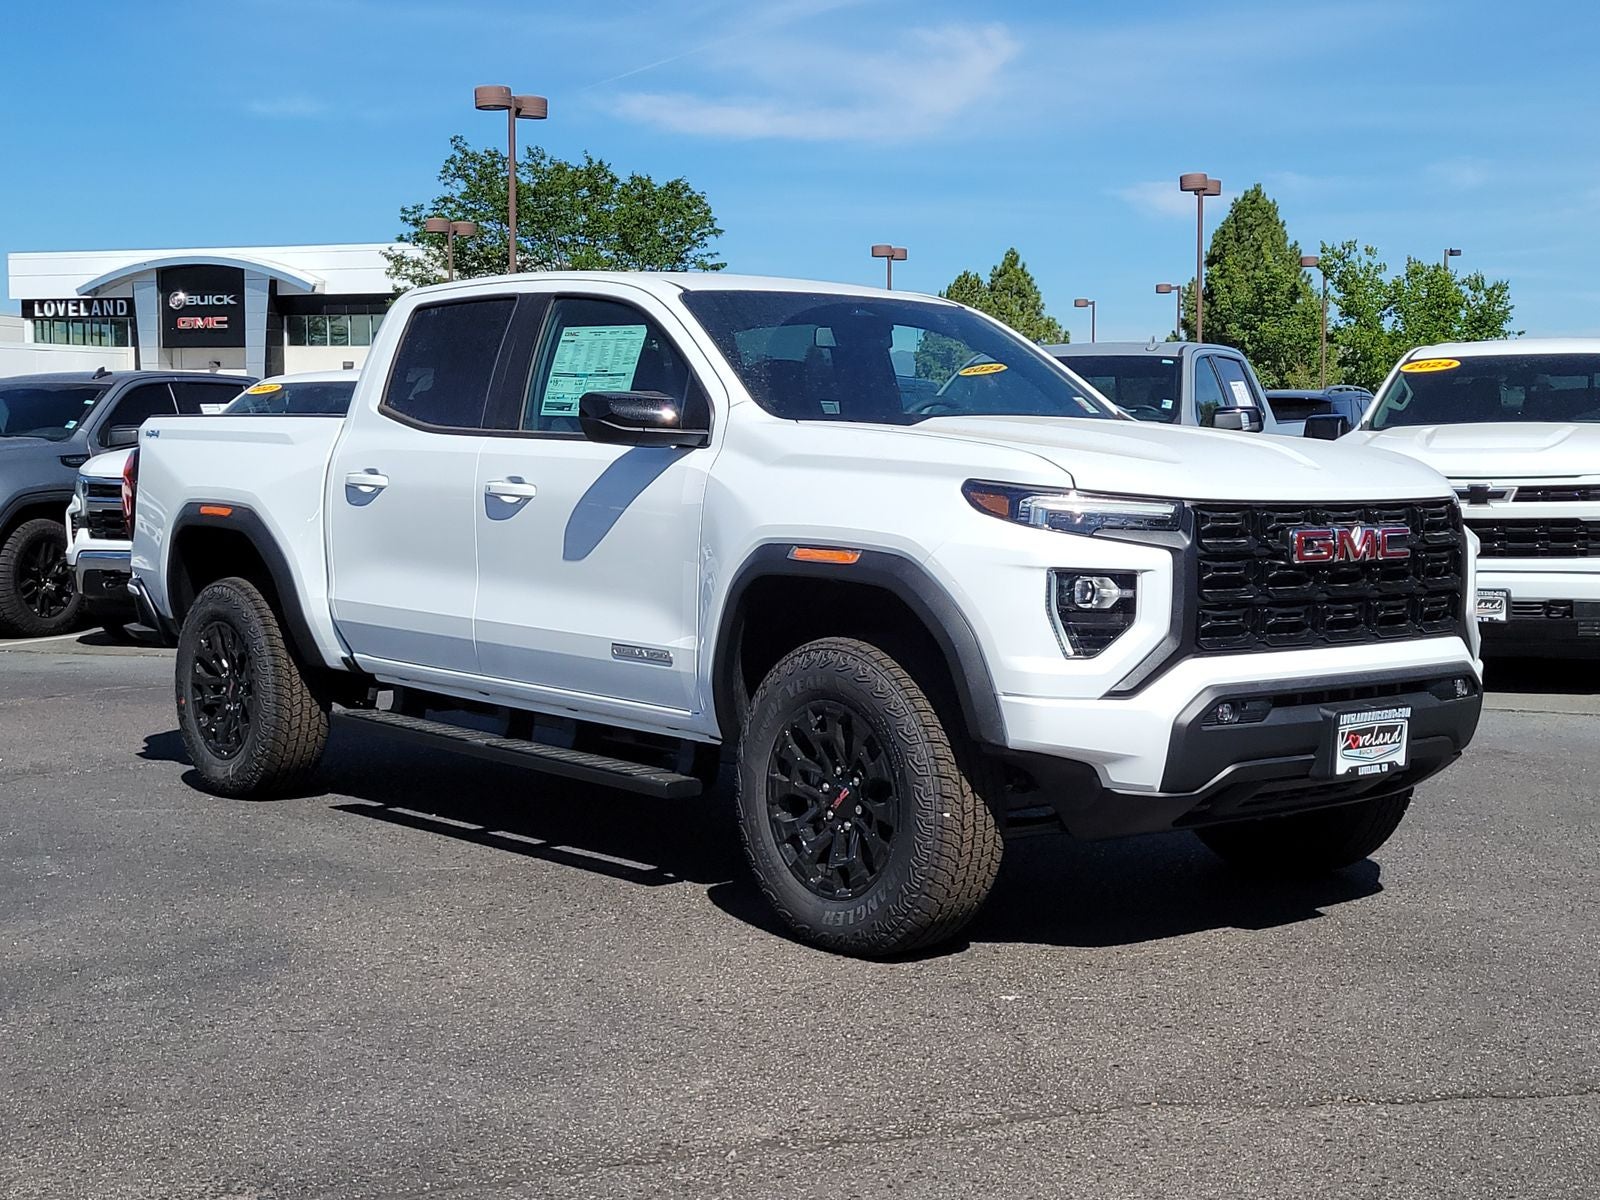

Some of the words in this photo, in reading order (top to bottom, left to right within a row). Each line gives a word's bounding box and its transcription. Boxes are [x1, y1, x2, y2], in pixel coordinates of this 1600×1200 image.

[185, 294, 238, 305] BUICK
[33, 300, 128, 318] LOVELAND
[177, 316, 228, 329] GMC
[1406, 361, 1455, 371] 2024
[1289, 526, 1411, 563] GMC
[1340, 725, 1401, 749] Loveland
